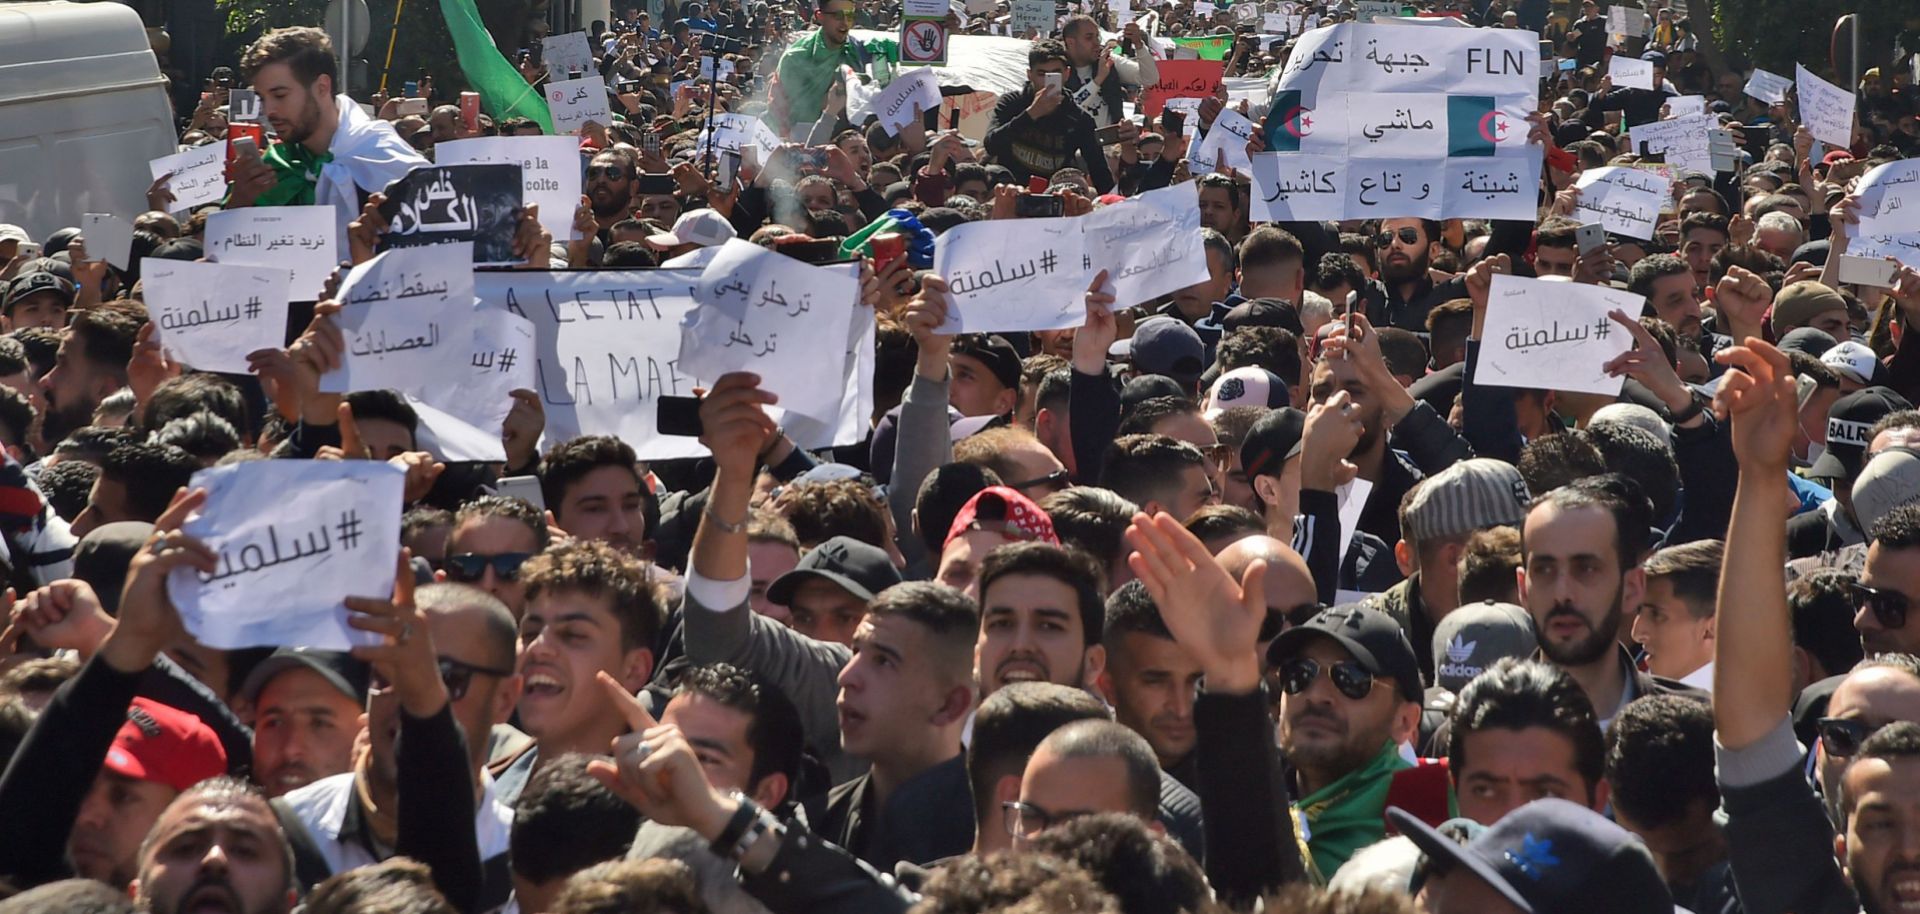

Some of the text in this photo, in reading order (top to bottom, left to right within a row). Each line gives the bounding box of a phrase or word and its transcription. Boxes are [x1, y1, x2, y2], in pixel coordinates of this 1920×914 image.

[1284, 39, 1523, 76] FLN جبهة تحرير
[567, 87, 588, 105] كفى
[1363, 109, 1433, 142] ماشي
[536, 157, 548, 169] la
[1263, 170, 1518, 205] شيتة و تاع كاشير
[1883, 170, 1919, 189] الشعب
[390, 188, 479, 236] الكلام
[1872, 196, 1902, 217] القرار
[224, 234, 262, 251] النظام
[267, 235, 294, 250] تغير
[299, 235, 325, 249] نريد
[396, 273, 448, 302] يسقط
[714, 272, 751, 301] يعني
[507, 287, 528, 319] A
[352, 322, 440, 361] العصابات
[537, 356, 592, 406] LA
